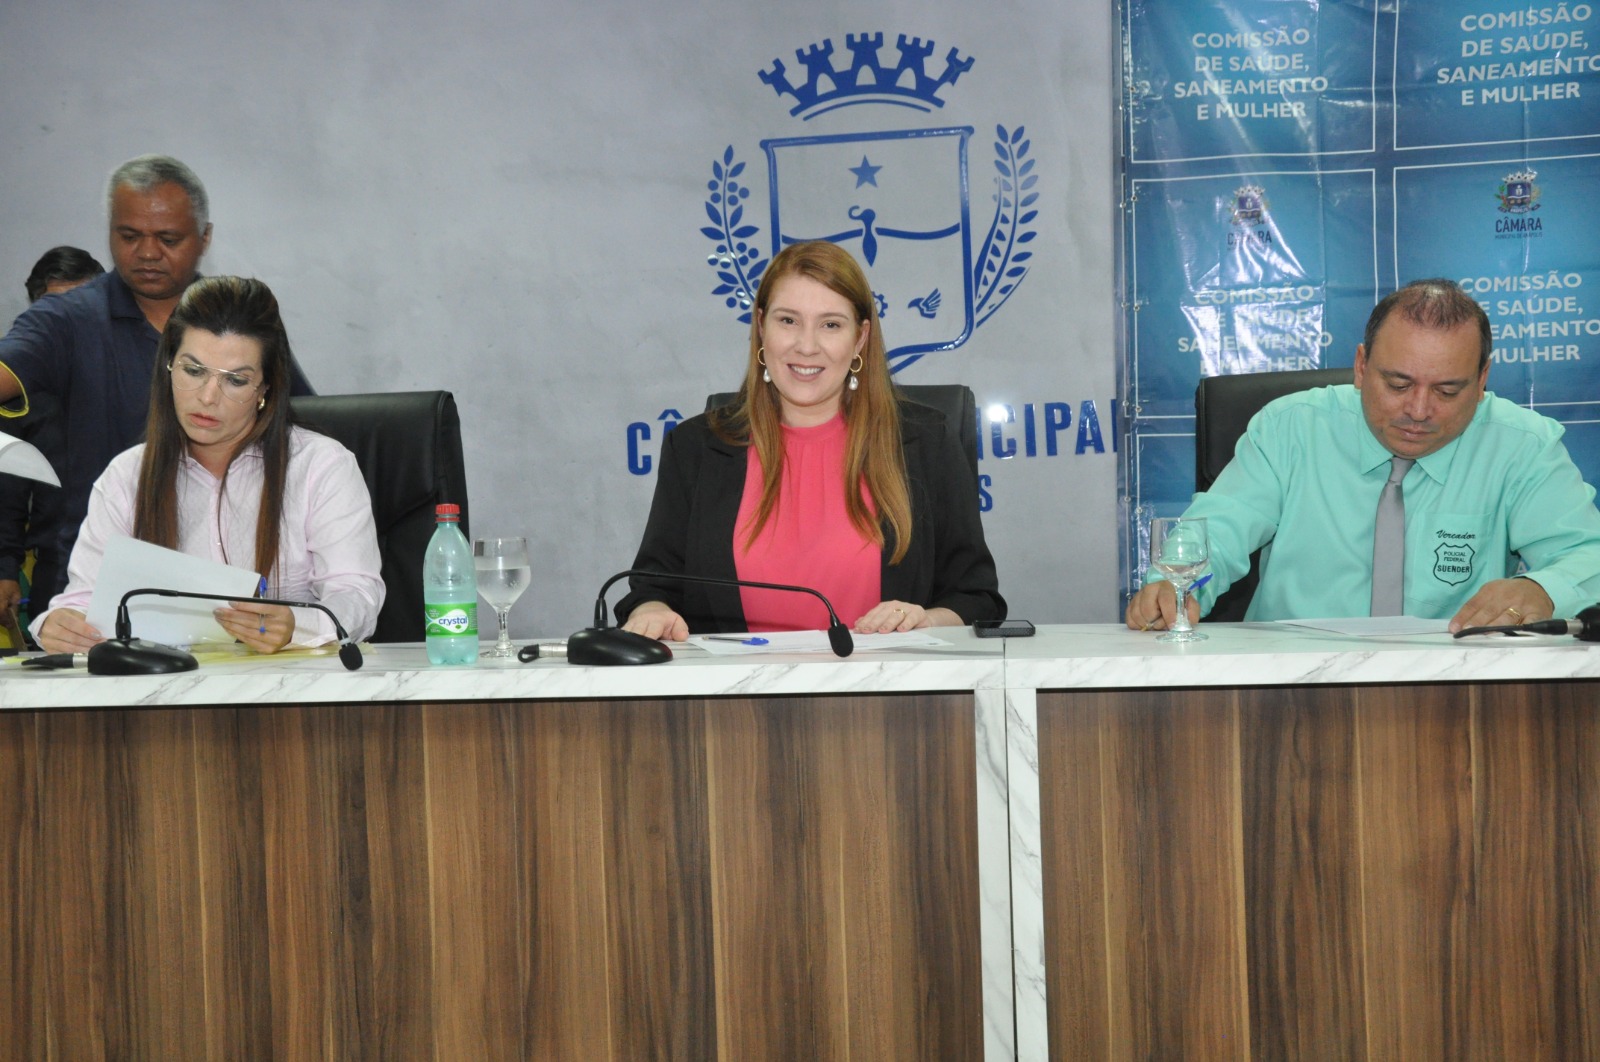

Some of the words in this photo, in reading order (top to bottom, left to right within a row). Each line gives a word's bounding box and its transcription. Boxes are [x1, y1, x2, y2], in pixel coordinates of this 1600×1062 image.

[1460, 2, 1592, 32] COMISSÃO
[1192, 25, 1310, 48] COMISSÃO
[1461, 39, 1494, 57] DE
[1500, 30, 1588, 54] SAÚDE,
[1195, 56, 1223, 72] DE
[1229, 52, 1310, 72] SAÚDE,
[1174, 76, 1328, 98] SANEAMENTO
[1461, 90, 1474, 106] E
[1481, 82, 1581, 104] MULHER
[1196, 104, 1209, 120] E
[1216, 102, 1306, 119] MULHER
[1495, 216, 1543, 233] CÂMARA
[1458, 270, 1582, 293] COMISSÃO
[1195, 282, 1314, 305] COMISSÃO
[1497, 294, 1583, 316] SAÚDE,
[1436, 529, 1476, 540] Vereador
[1437, 564, 1470, 573] SUENDER
[438, 616, 467, 626] crystal
